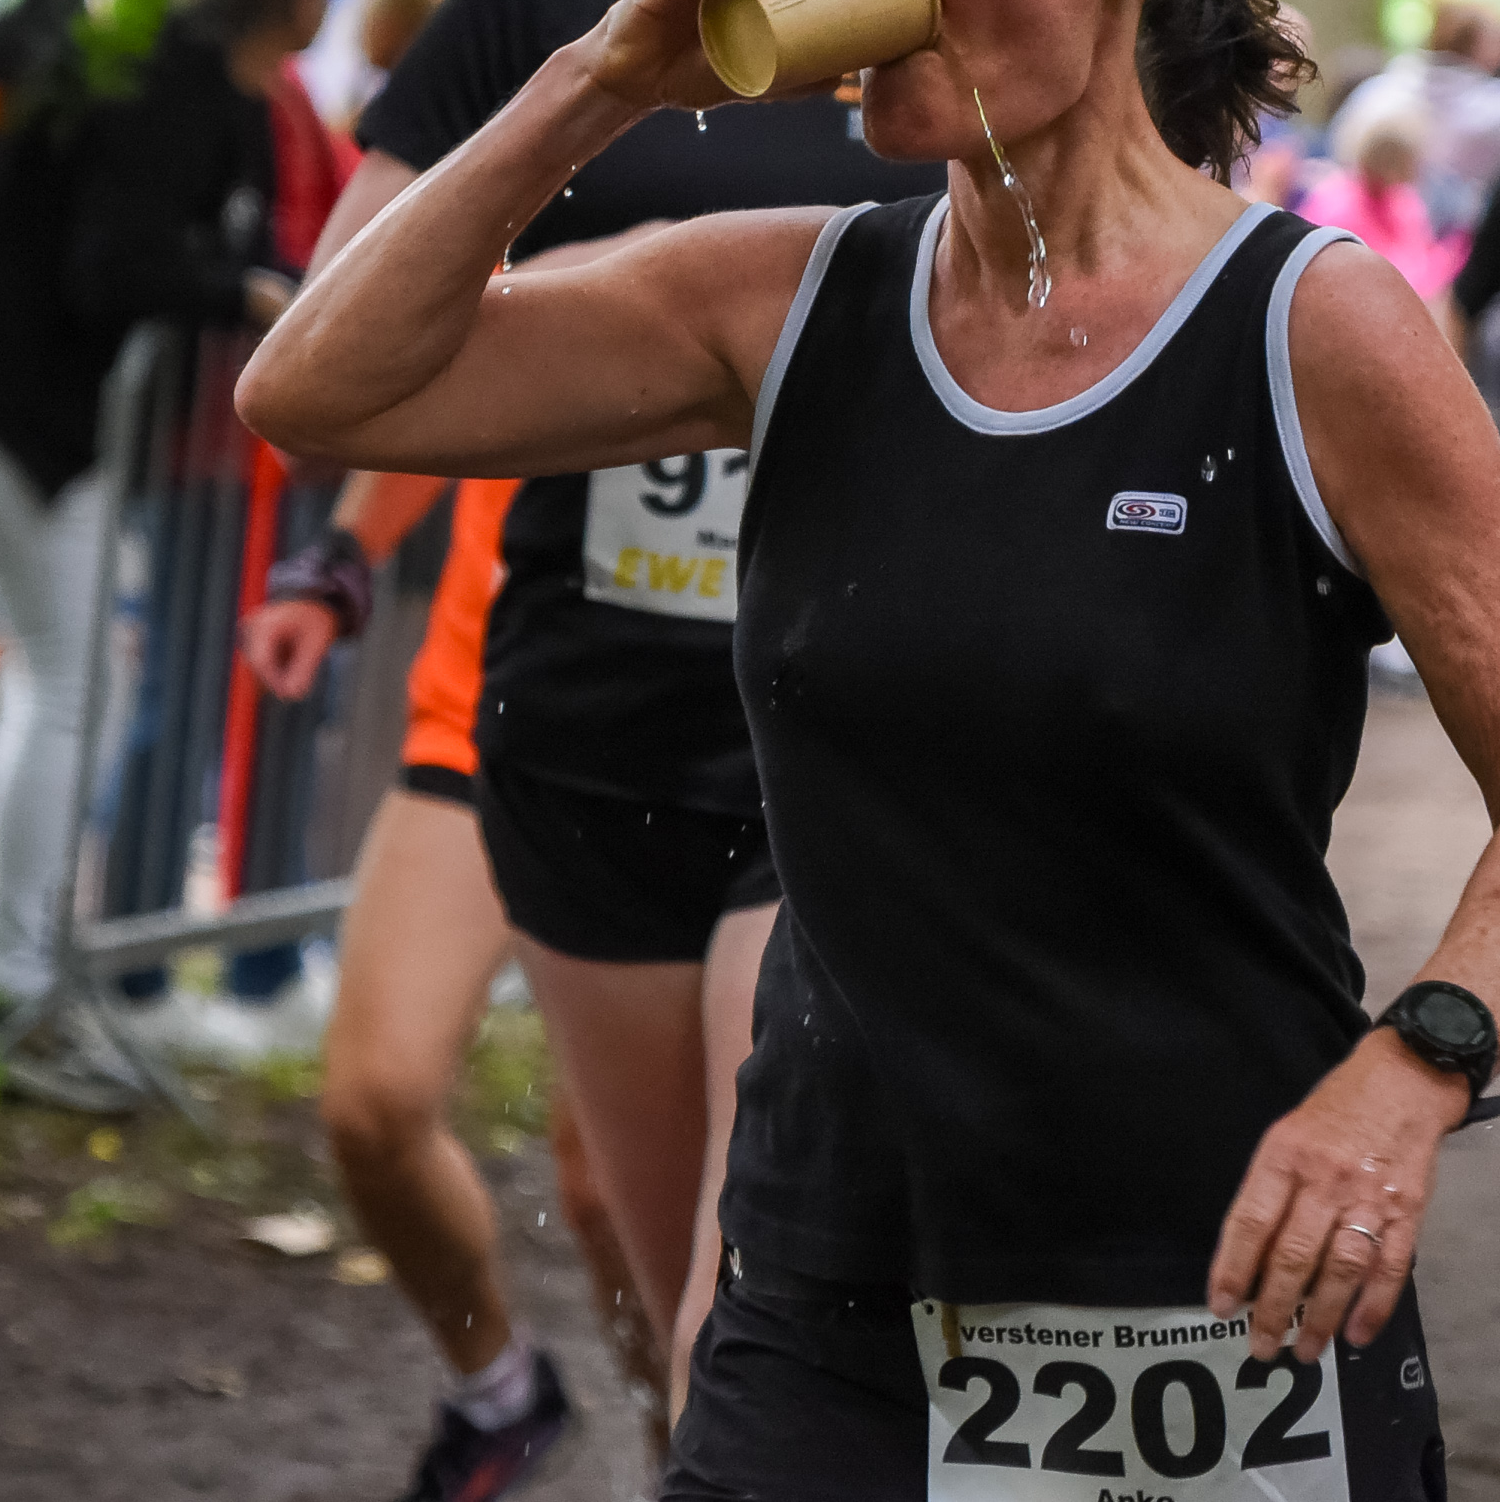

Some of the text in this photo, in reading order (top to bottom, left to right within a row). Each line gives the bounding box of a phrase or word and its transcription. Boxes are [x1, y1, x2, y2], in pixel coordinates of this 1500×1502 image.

[613, 546, 728, 598] EWE
[961, 1322, 1104, 1348] verstener
[937, 1344, 1333, 1479] 2202
